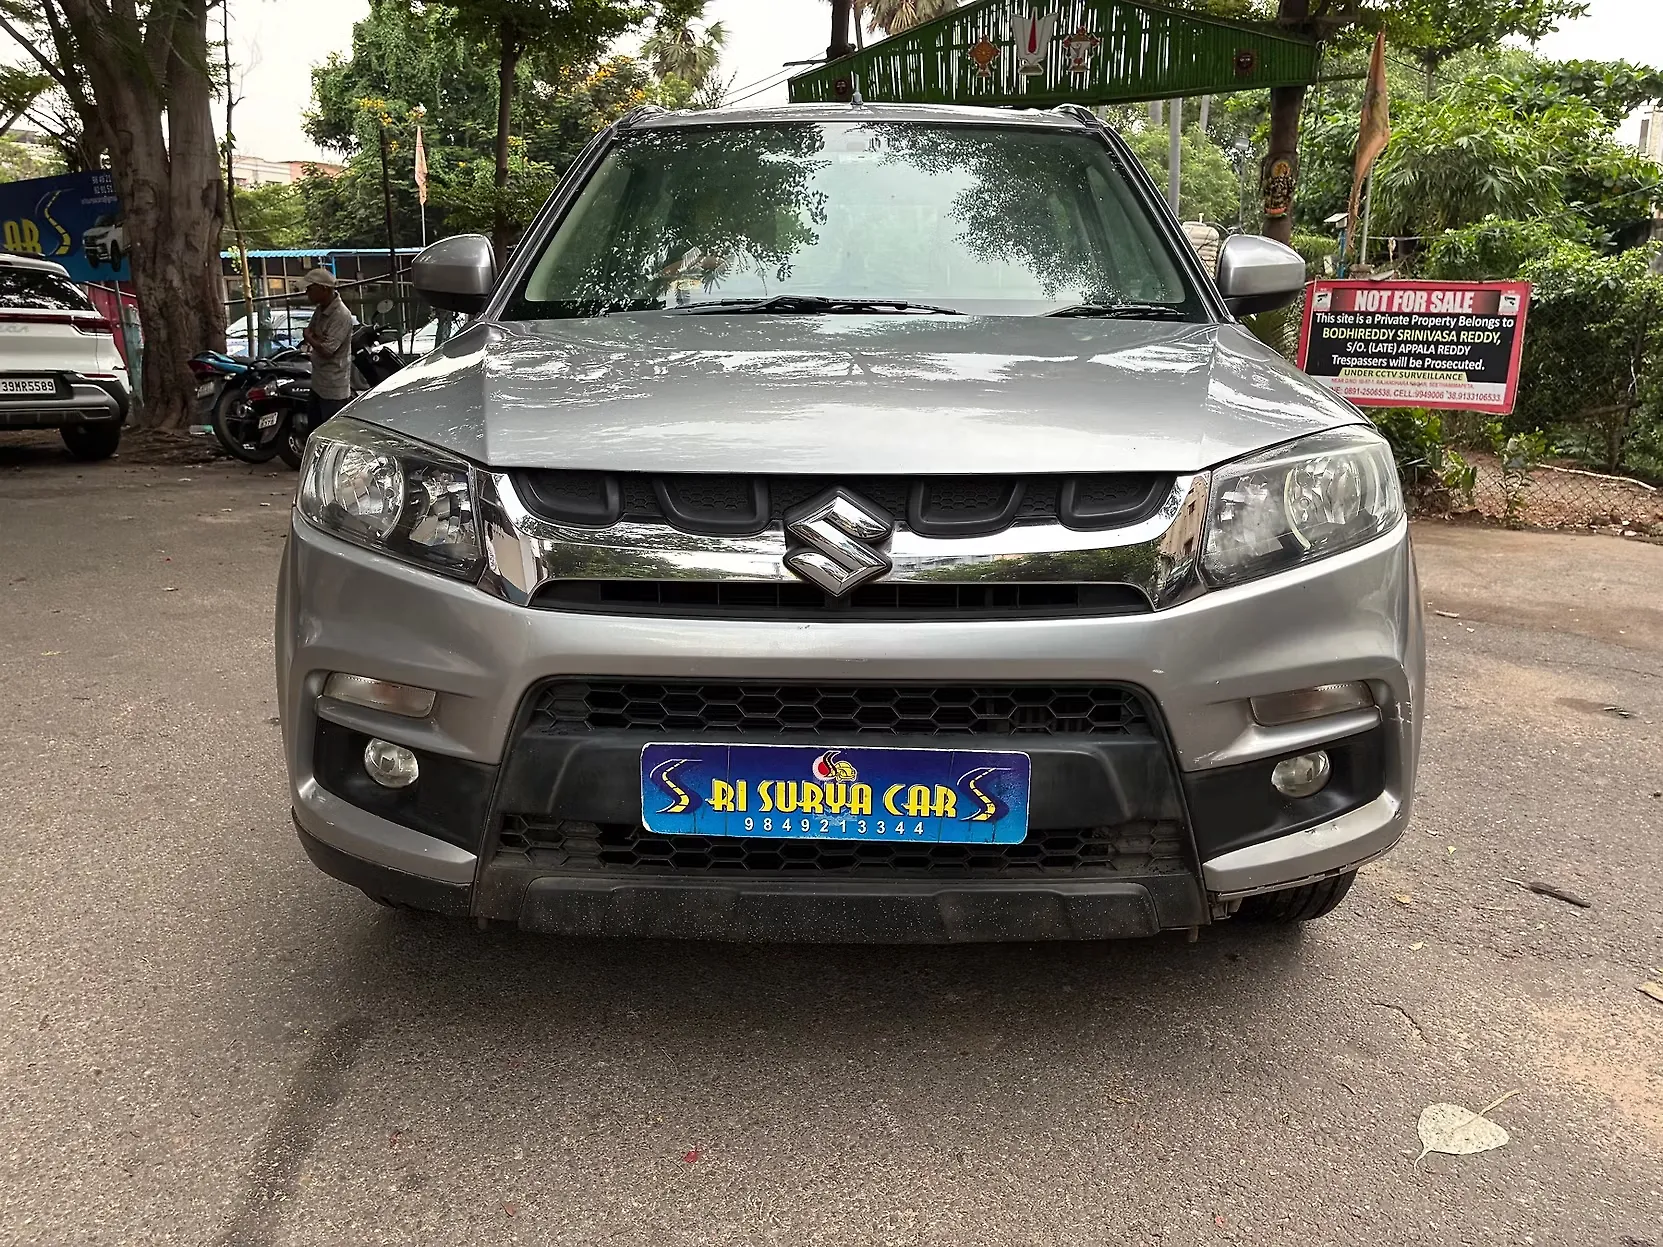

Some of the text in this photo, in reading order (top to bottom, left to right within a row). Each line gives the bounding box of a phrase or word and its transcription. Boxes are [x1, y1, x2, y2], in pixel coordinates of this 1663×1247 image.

[1354, 290, 1475, 314] NOT FOR SALE
[1316, 313, 1514, 330] This site is a Private Property Belongs to
[1322, 327, 1502, 346] BODHIREDDY SRINIVASA REDDY,
[1346, 341, 1472, 356] S/O. (LATE) APPALA REDDY
[1331, 354, 1486, 371] Trespassers will be Prosecuted.
[1344, 369, 1464, 381] UNDER CCTV SURVEILLANCE
[757, 779, 873, 816] SURYA
